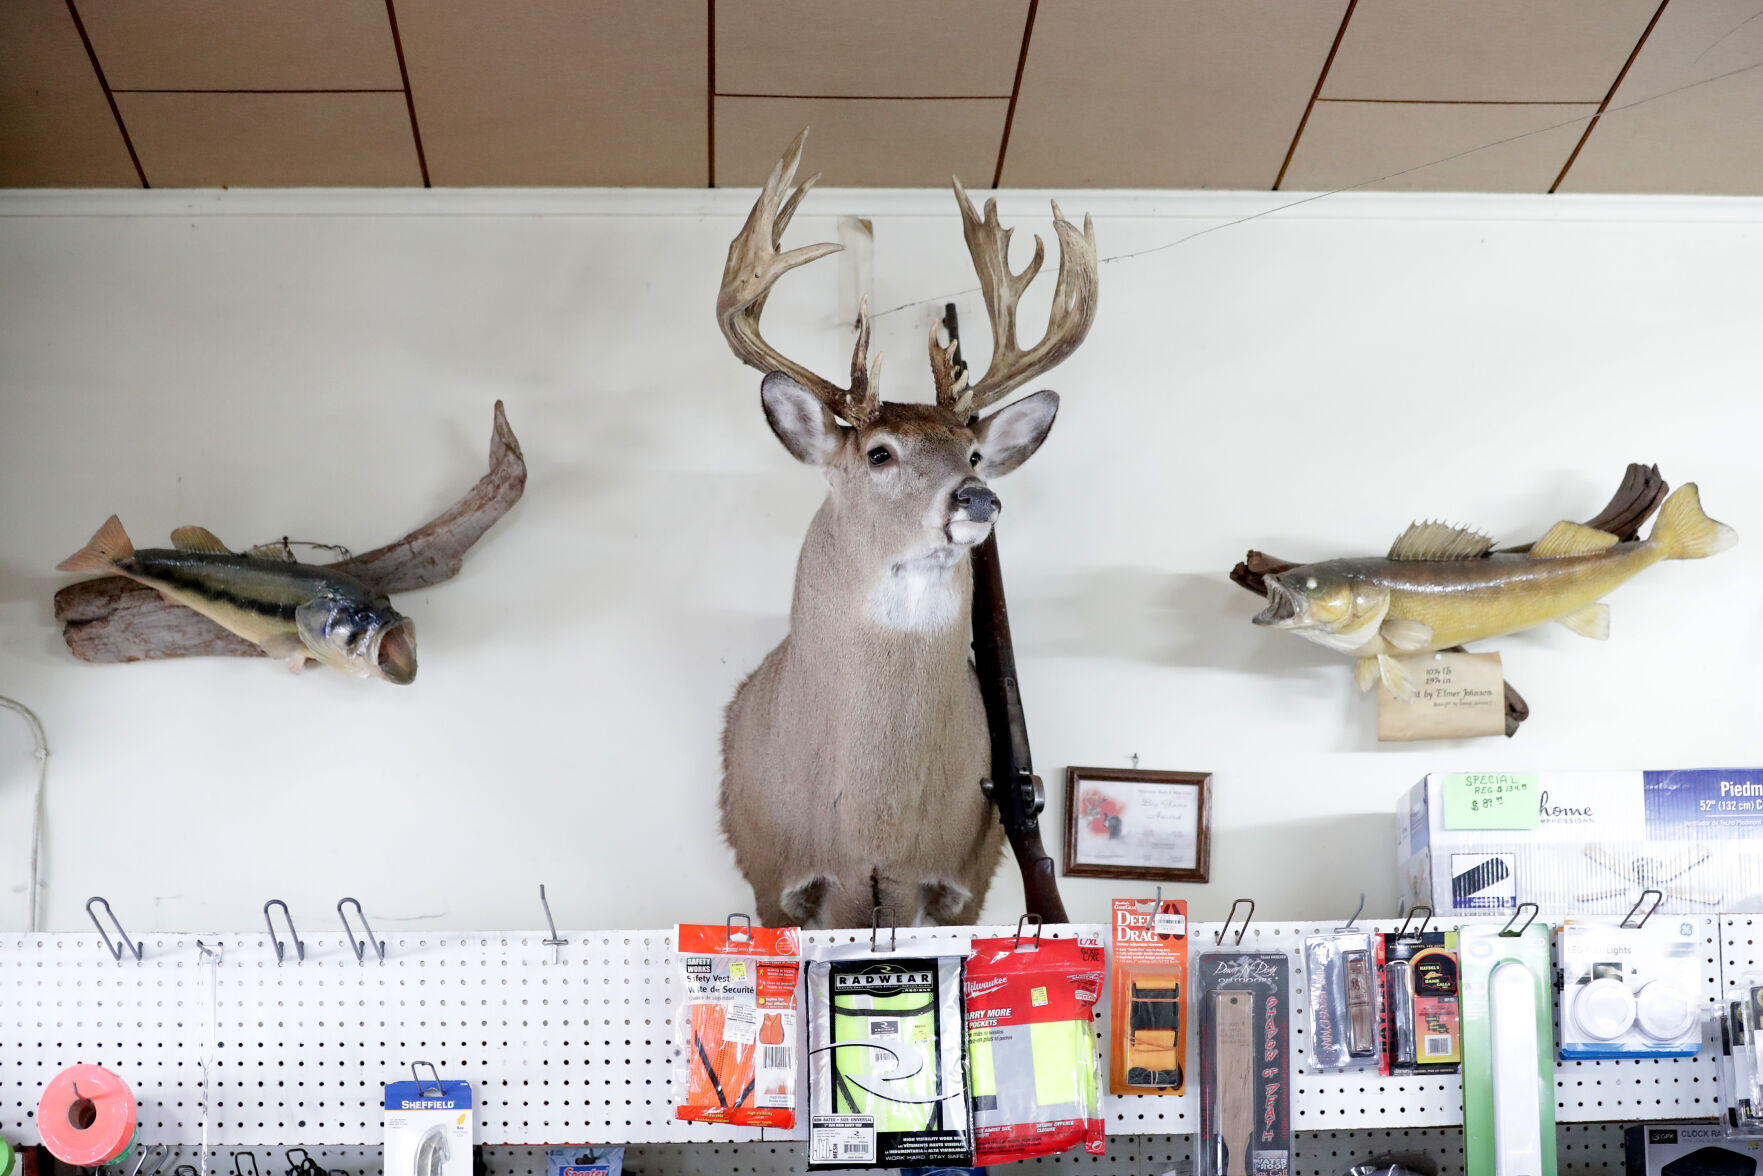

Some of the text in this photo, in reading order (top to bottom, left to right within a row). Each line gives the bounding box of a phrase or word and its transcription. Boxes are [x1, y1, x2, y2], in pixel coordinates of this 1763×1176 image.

[1424, 690, 1433, 700] by
[1436, 688, 1460, 698] Elmer
[1463, 688, 1493, 700] Johnson
[1465, 775, 1519, 787] SPECIAL
[1475, 786, 1493, 795] REG
[1540, 790, 1593, 817] home
[1718, 800, 1737, 811] (132
[1738, 800, 1754, 811] cm)
[1117, 926, 1158, 942] DRAG
[1607, 945, 1632, 956] Lights
[839, 974, 929, 985] RADWEAR
[723, 985, 754, 994] Securité
[987, 1008, 1012, 1017] MORE
[969, 1020, 998, 1028] POCKETS
[1264, 996, 1279, 1062] SHADOW
[1262, 1067, 1279, 1078] OF
[402, 1100, 455, 1109] SHEFFIELD
[1262, 1083, 1281, 1141] DEATH
[1681, 1130, 1709, 1138] CLOCK
